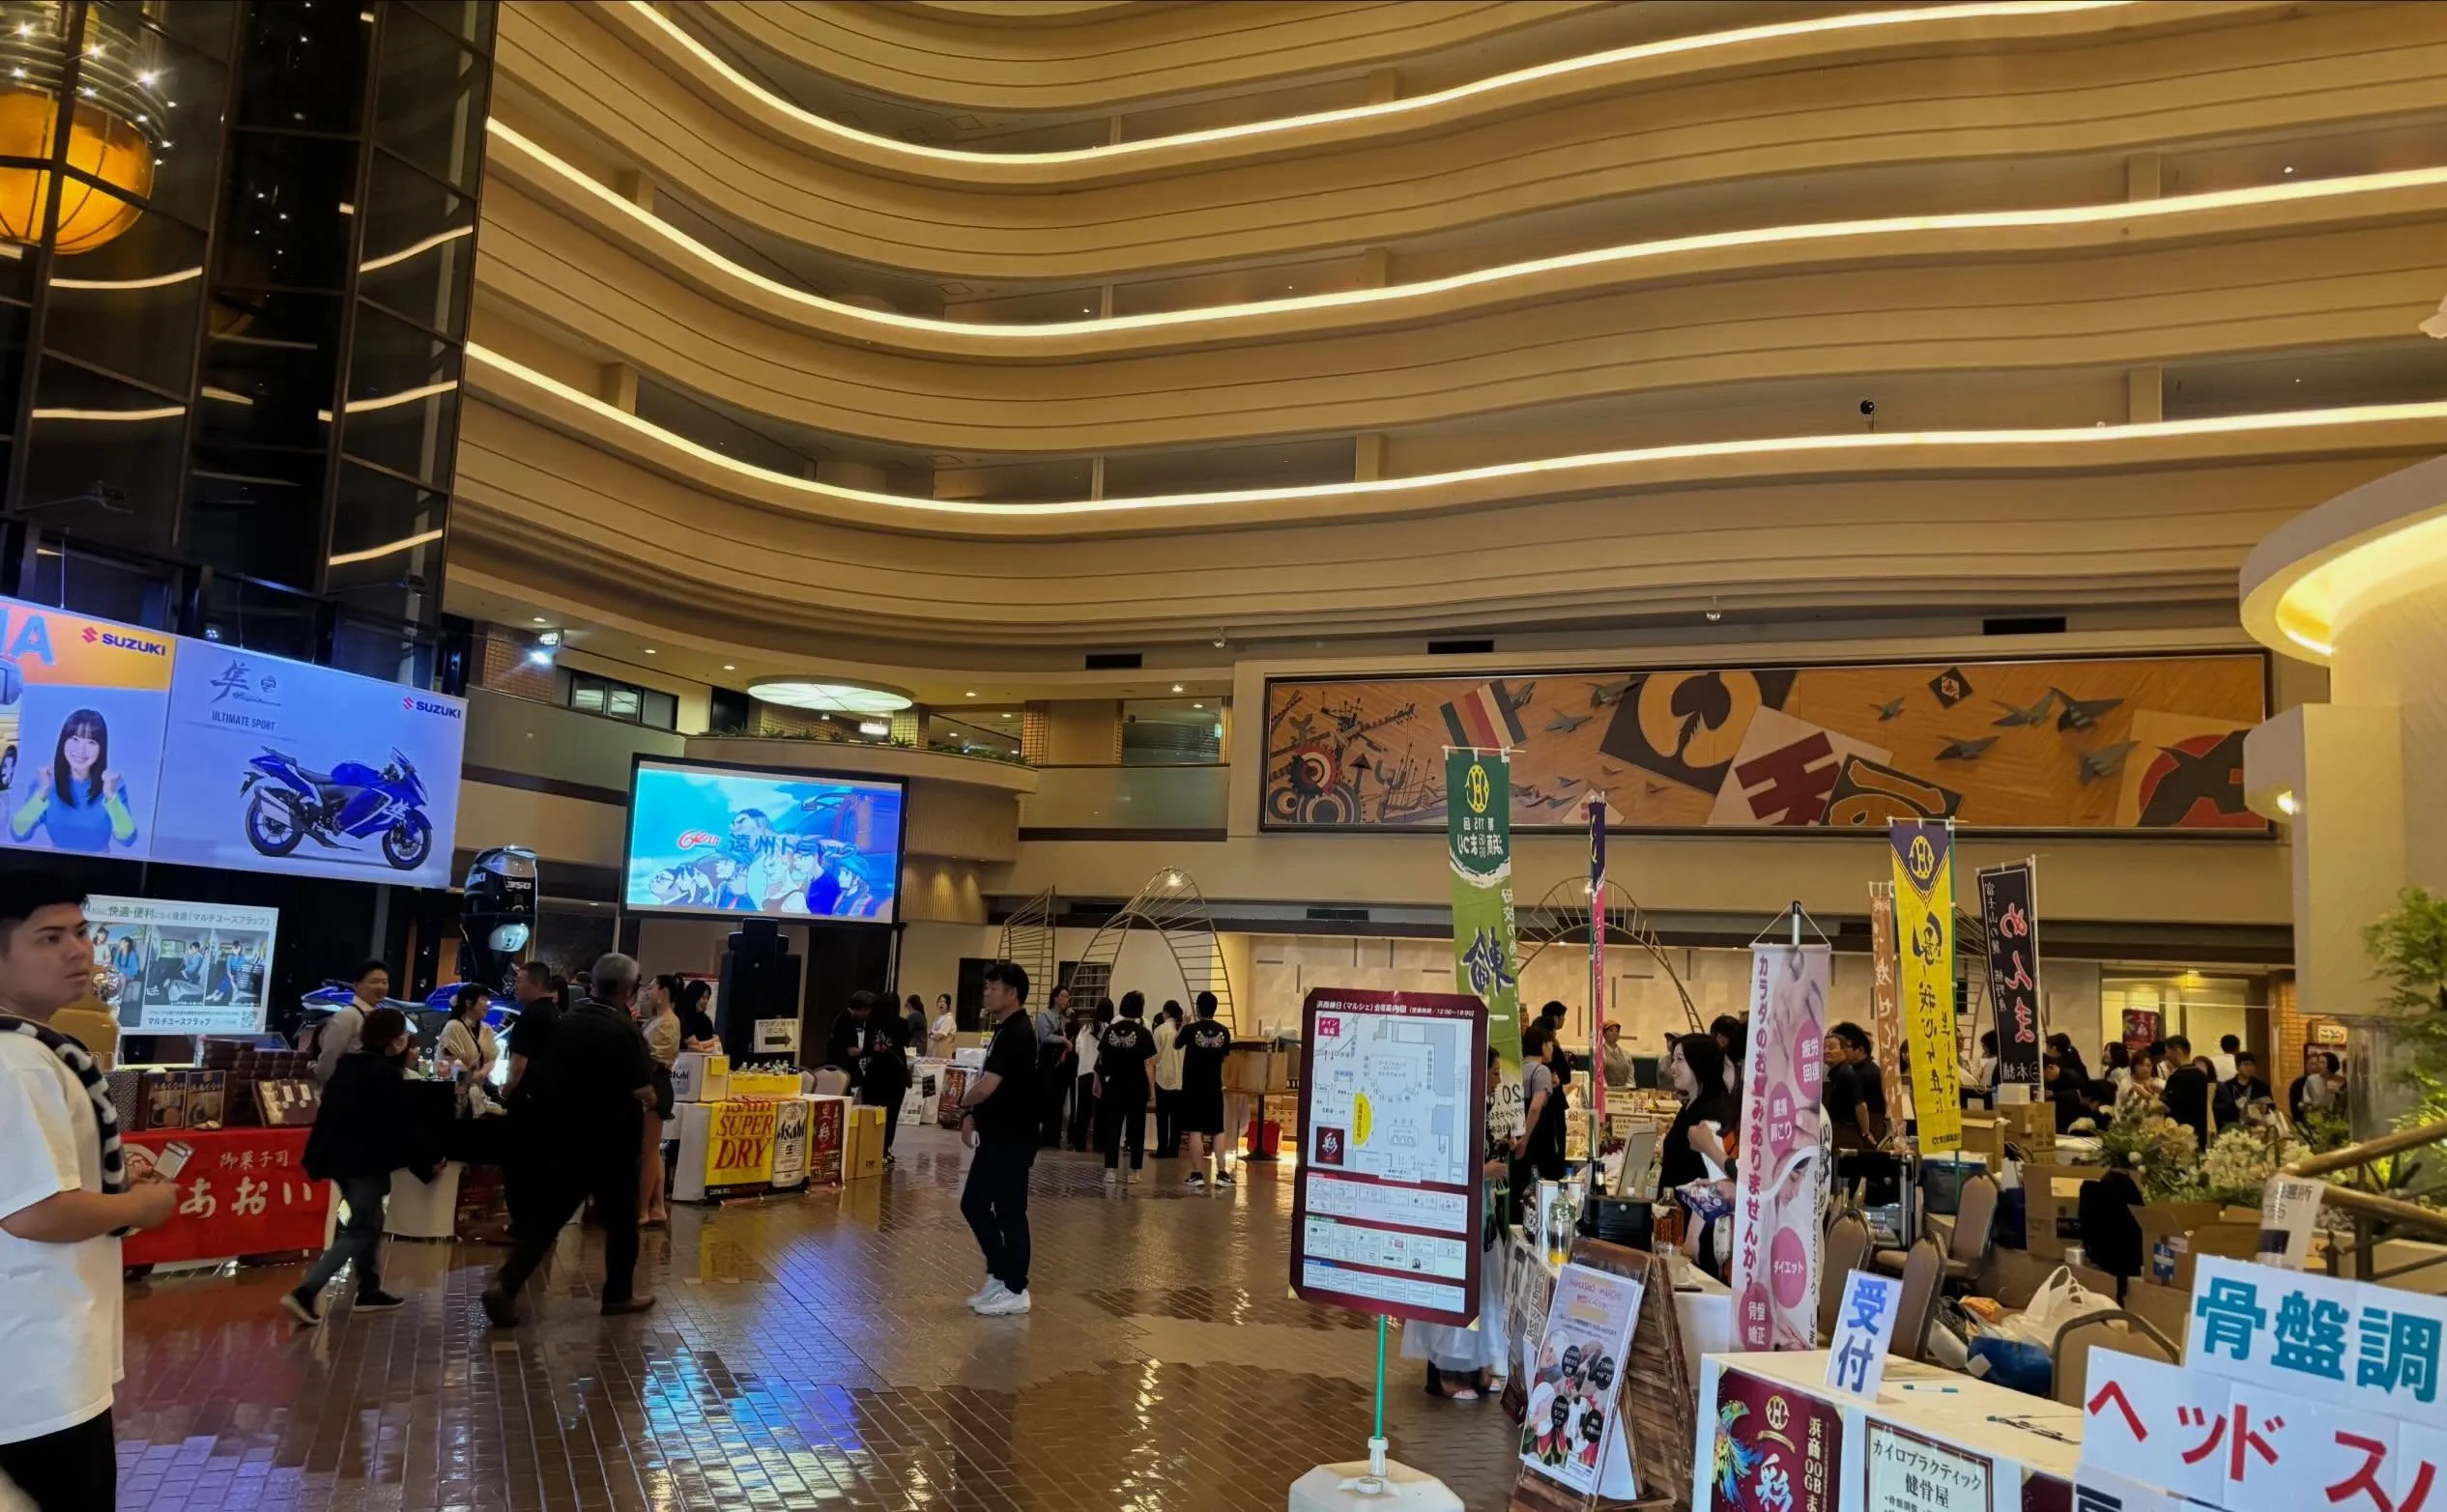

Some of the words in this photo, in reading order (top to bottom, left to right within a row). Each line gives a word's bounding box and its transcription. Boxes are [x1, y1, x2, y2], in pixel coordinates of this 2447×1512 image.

[101, 632, 166, 657] SUZUKI
[210, 659, 250, 703] 隼
[212, 710, 249, 727] ULTIMATE
[251, 718, 275, 730] SPORT
[416, 699, 462, 719] SUZUKI
[730, 833, 859, 858] 遠州トラック
[716, 1114, 773, 1136] SUPER
[777, 1118, 806, 1140] Asahi
[219, 1149, 289, 1169] 御菓子司
[712, 1137, 771, 1169] DRY
[179, 1177, 312, 1217] あおい
[1772, 1259, 1804, 1275] ダイエット
[1838, 1278, 1888, 1393] 受付
[2196, 1276, 2443, 1403] 骨盤調
[1873, 1440, 1982, 1491] カイロプラクティック
[1906, 1472, 1949, 1508] 健骨屋
